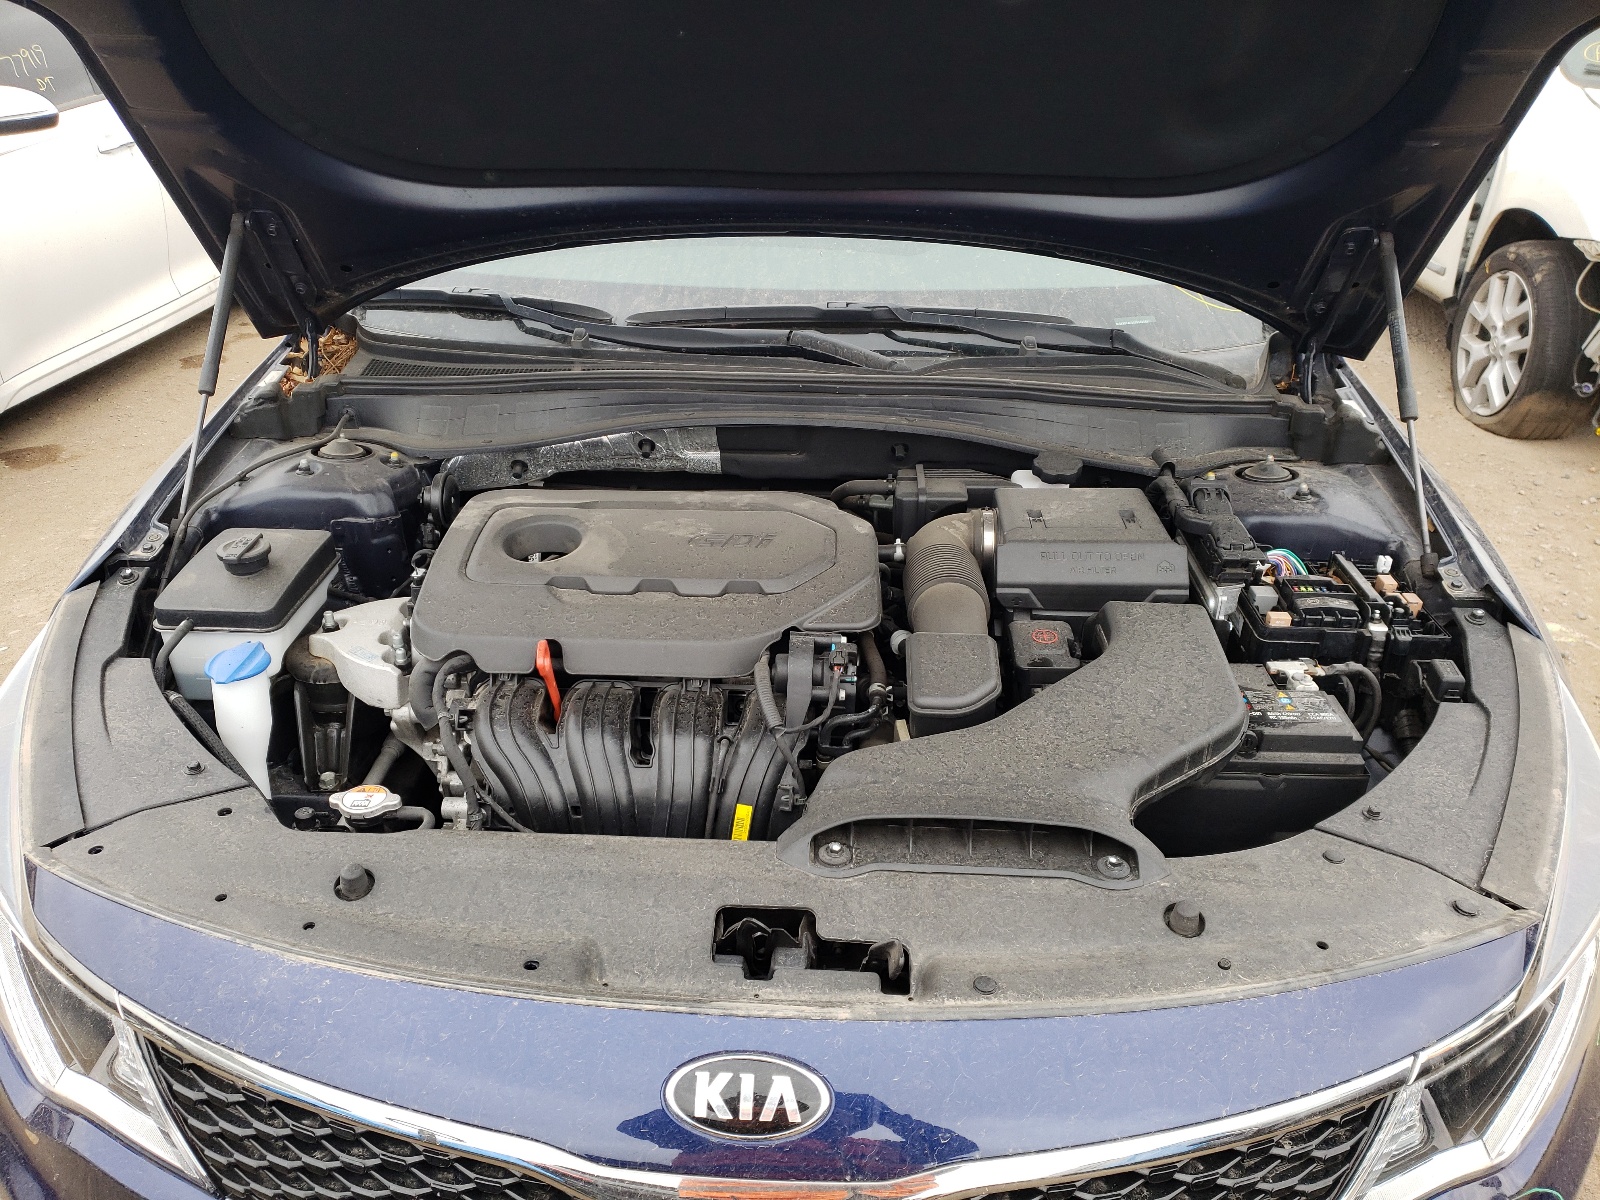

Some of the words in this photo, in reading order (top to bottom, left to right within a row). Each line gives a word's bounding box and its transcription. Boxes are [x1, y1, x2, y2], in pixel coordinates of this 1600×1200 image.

[1071, 552, 1093, 561] OUT
[1095, 552, 1112, 561] TO
[694, 1071, 802, 1122] KIA
